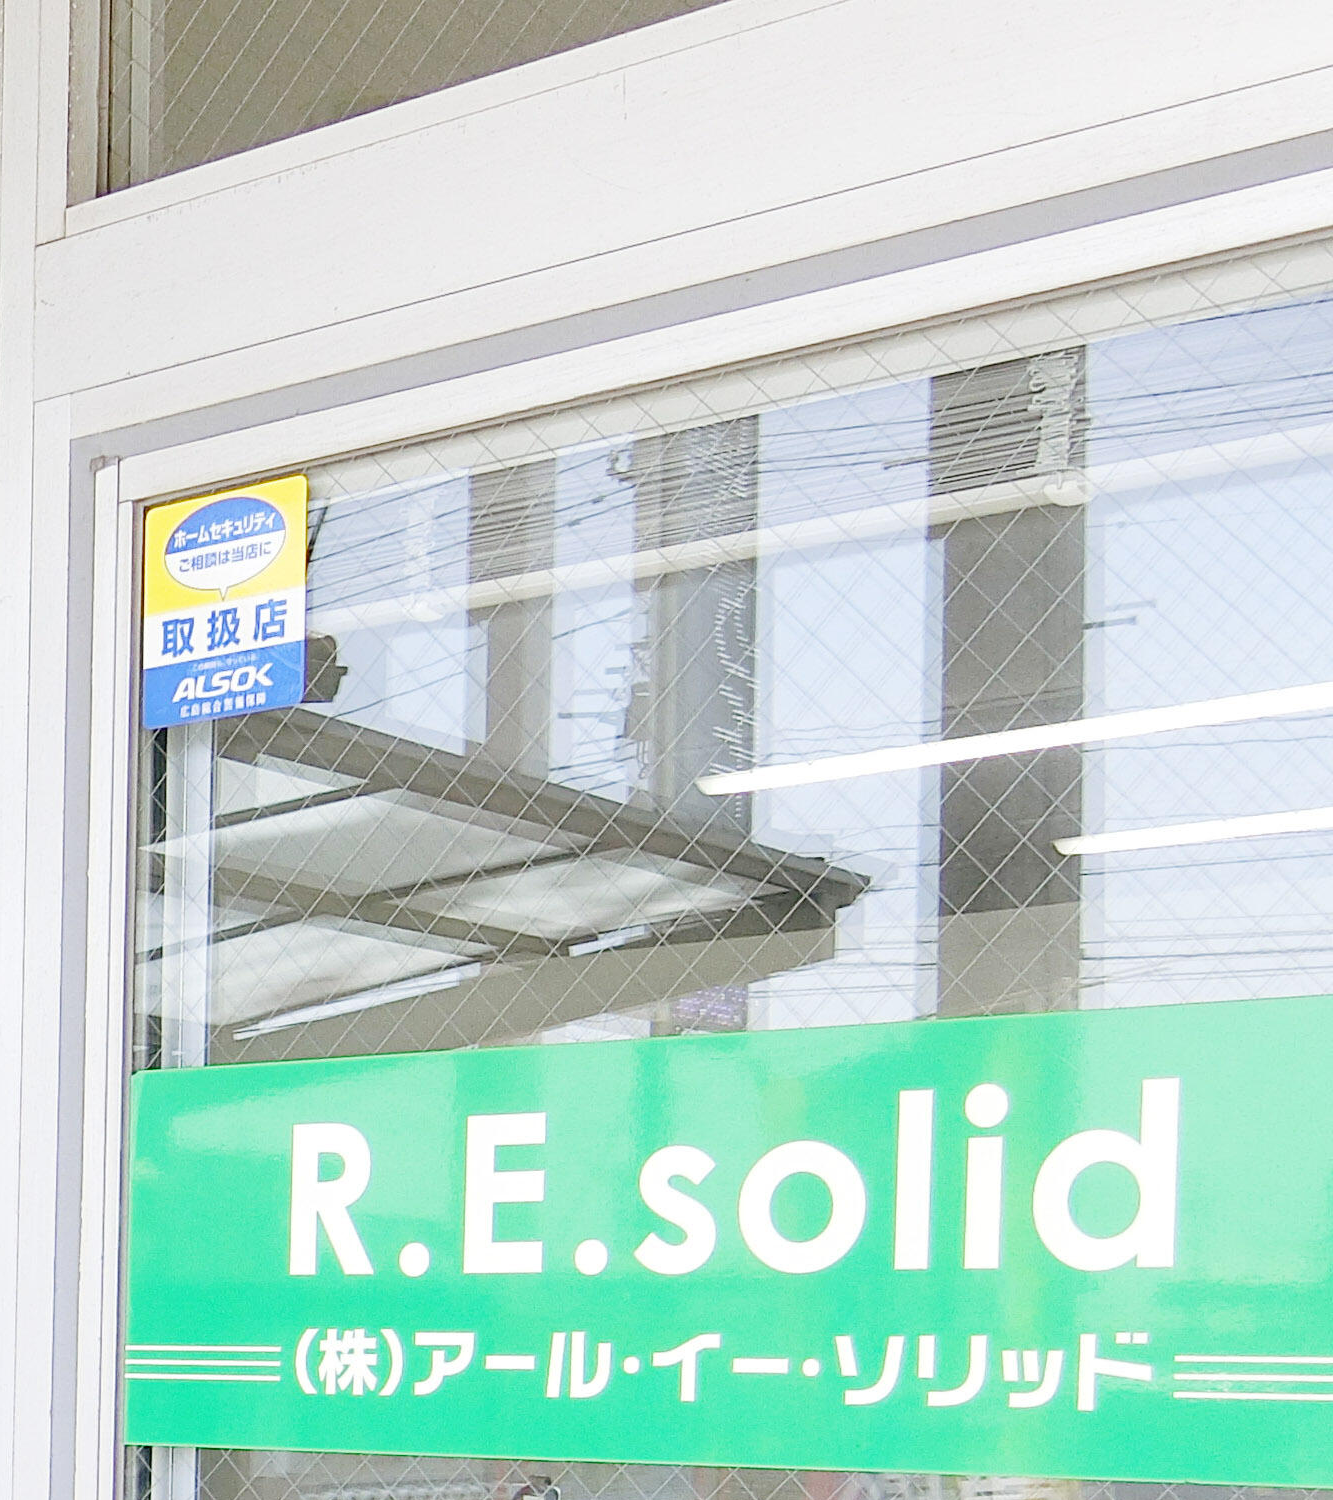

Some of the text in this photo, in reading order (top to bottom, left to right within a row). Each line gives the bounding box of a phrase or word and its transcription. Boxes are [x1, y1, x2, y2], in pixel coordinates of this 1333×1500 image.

[174, 512, 276, 548] ホームセキュリティ
[179, 541, 272, 572] ご相談は当店に
[161, 599, 287, 658] 取扱店
[172, 663, 273, 703] ALSOK
[288, 1077, 1181, 1277] R.E.solid
